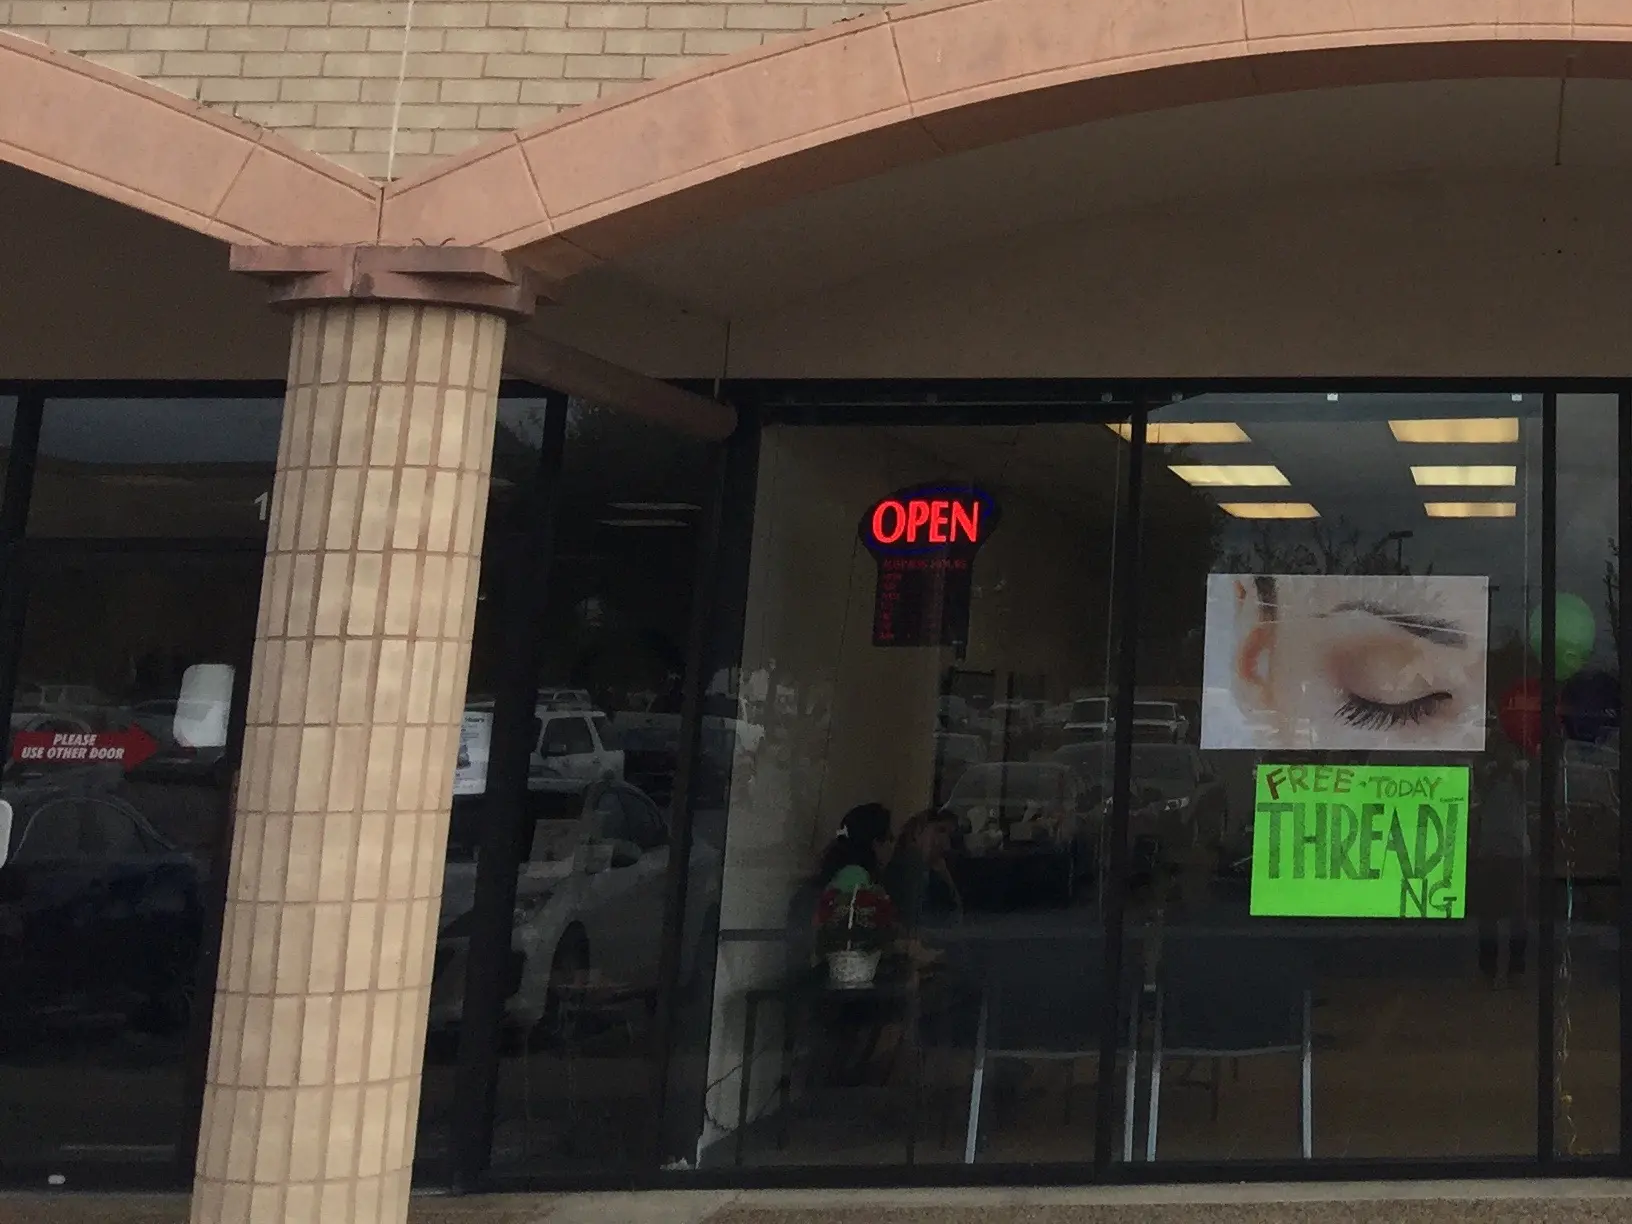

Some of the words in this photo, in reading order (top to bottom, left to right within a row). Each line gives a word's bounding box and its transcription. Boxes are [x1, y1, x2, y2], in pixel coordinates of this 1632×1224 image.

[872, 499, 980, 544] OPEN
[21, 747, 43, 759] USE
[46, 747, 86, 759] OTHER
[89, 747, 126, 760] DOOR
[53, 733, 98, 746] PLEASE
[1265, 764, 1355, 800] FREE
[1368, 775, 1442, 800] TODAY
[1400, 876, 1458, 919] NG
